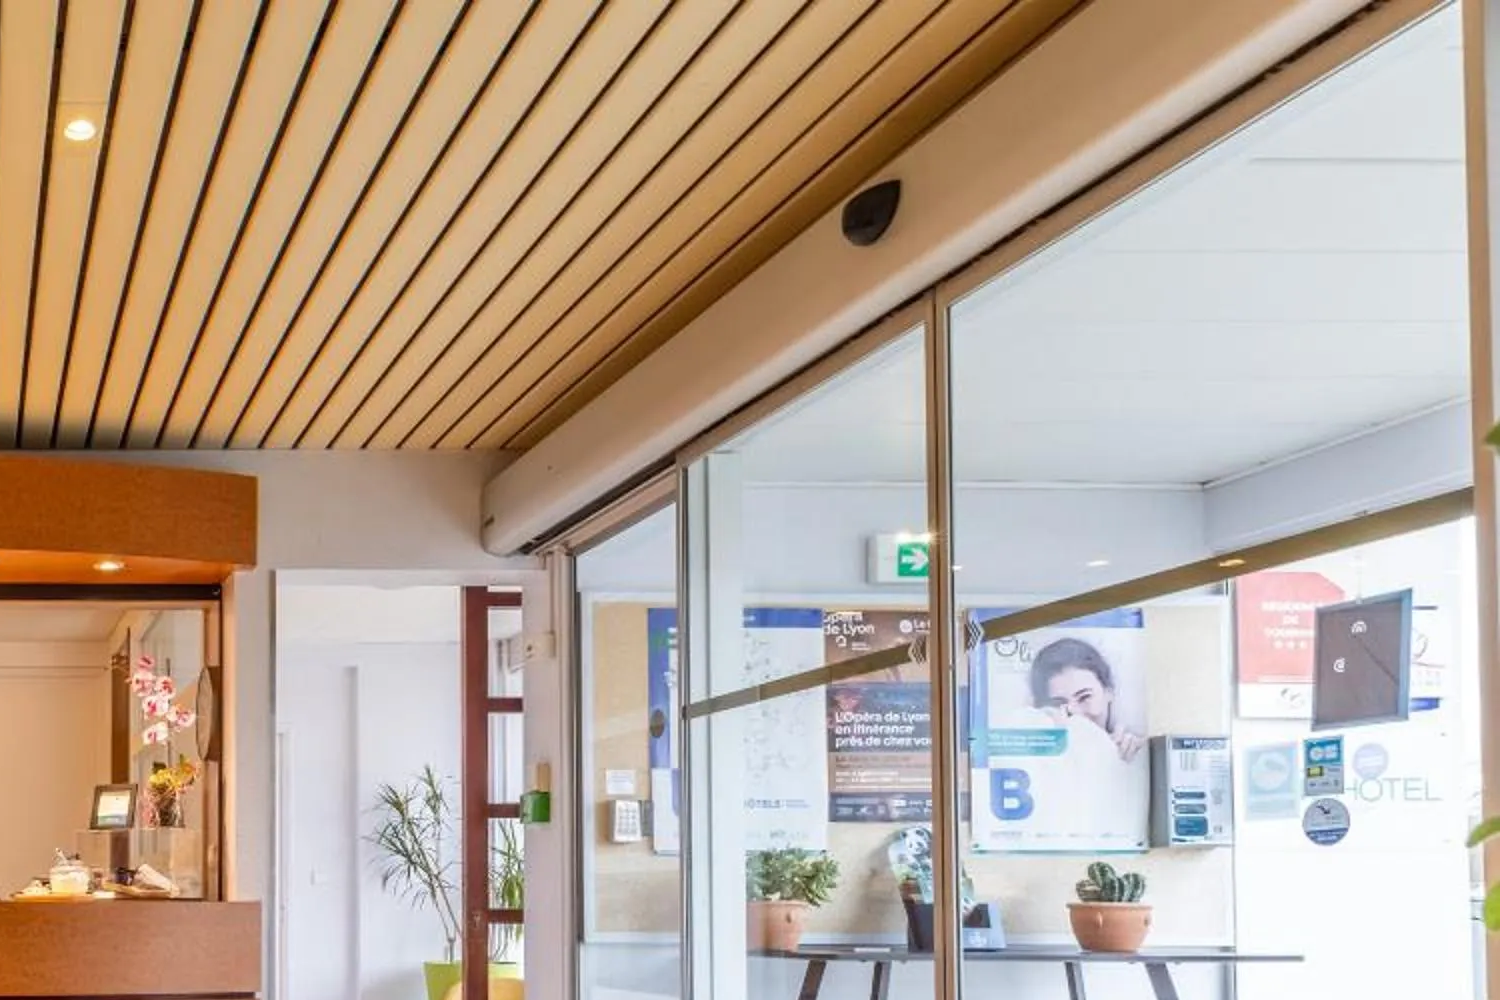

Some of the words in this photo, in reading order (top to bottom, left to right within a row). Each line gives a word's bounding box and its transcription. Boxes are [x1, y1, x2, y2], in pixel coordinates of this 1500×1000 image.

[843, 623, 876, 636] Lyon
[884, 711, 900, 722] de
[902, 711, 931, 724] Lyon
[835, 725, 851, 734] en
[866, 735, 881, 745] de
[990, 767, 1034, 820] B
